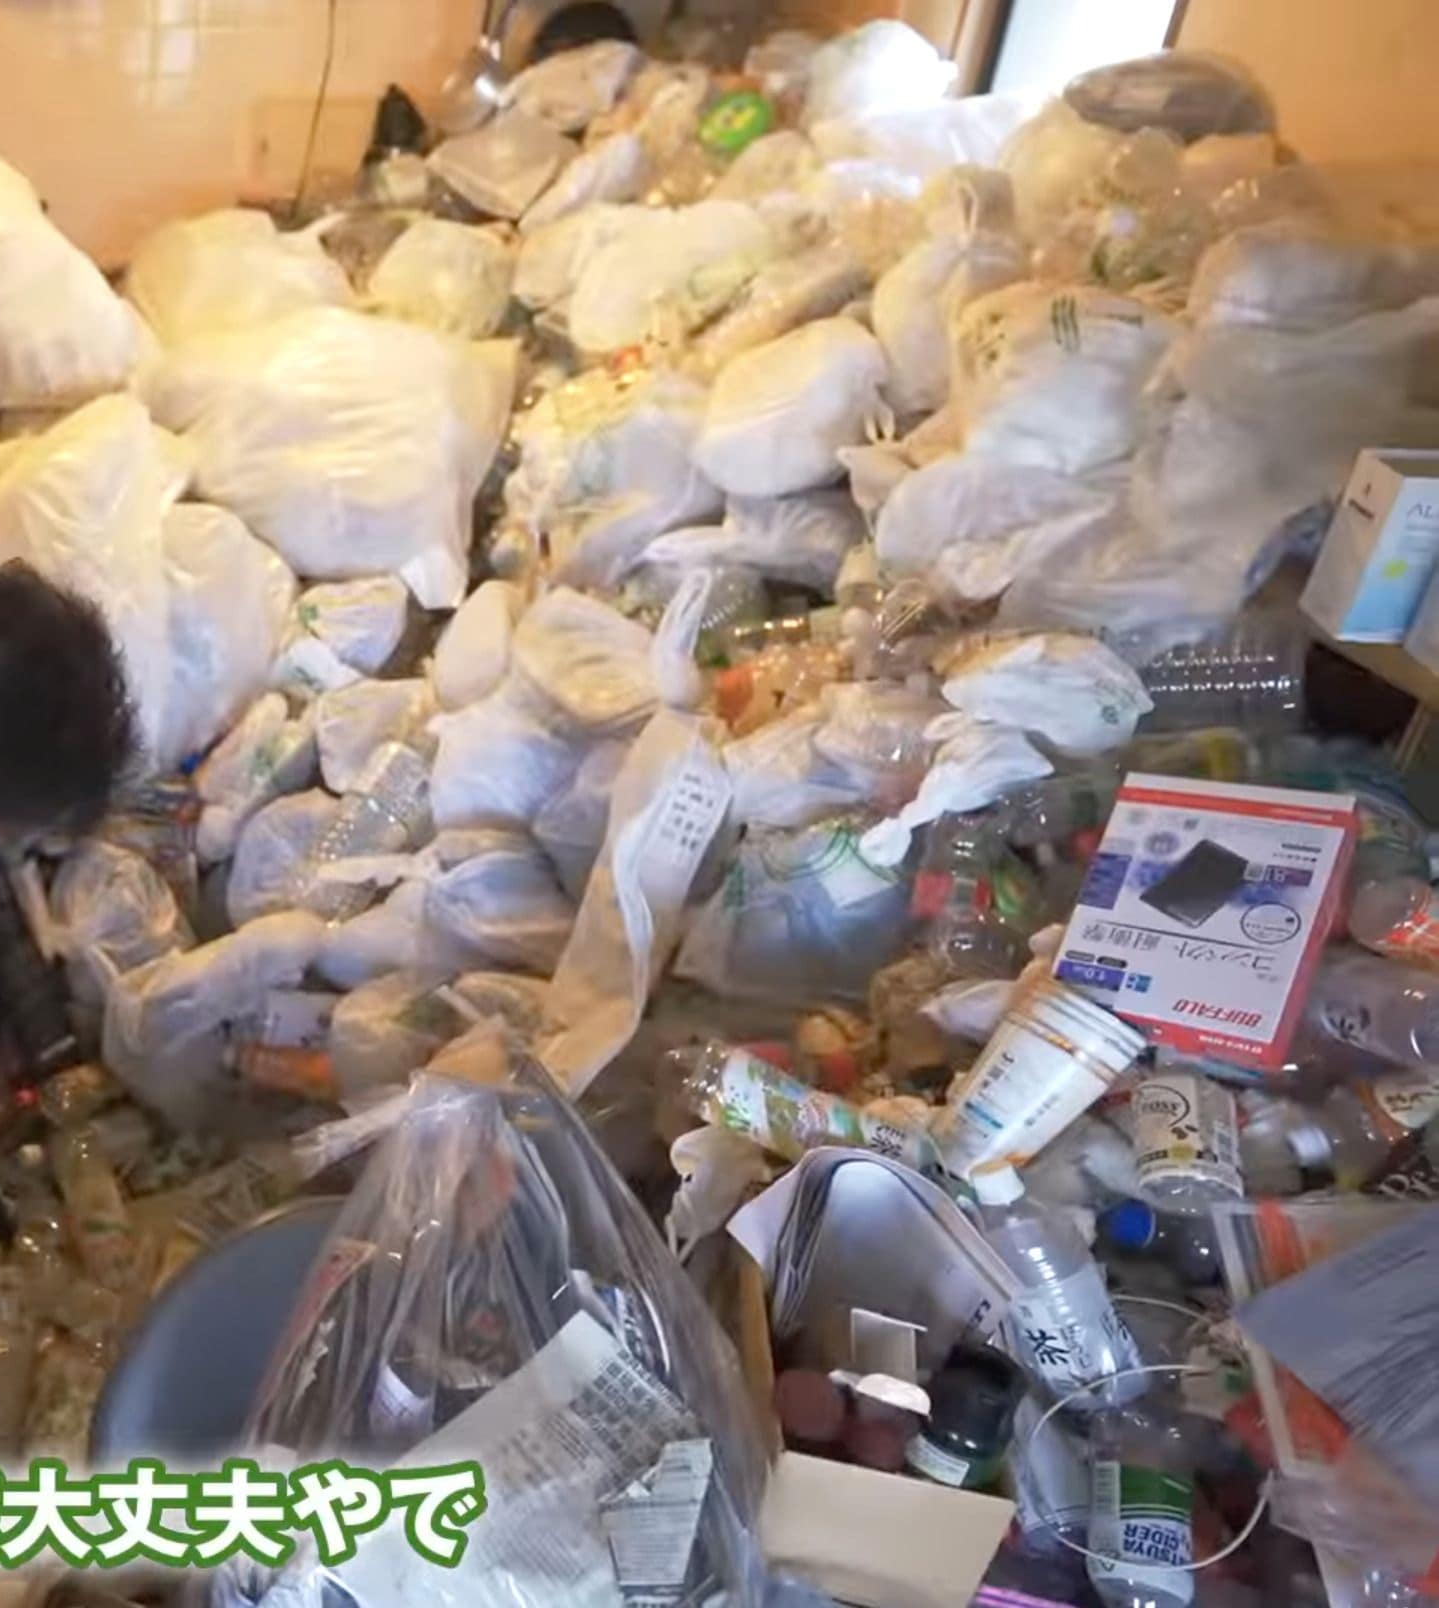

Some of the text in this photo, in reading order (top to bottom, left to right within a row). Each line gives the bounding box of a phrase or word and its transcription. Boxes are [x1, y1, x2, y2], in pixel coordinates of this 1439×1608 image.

[1175, 940, 1277, 972] コンパクト
[1173, 999, 1262, 1028] BUFFALO
[1124, 1523, 1180, 1549] CIDER
